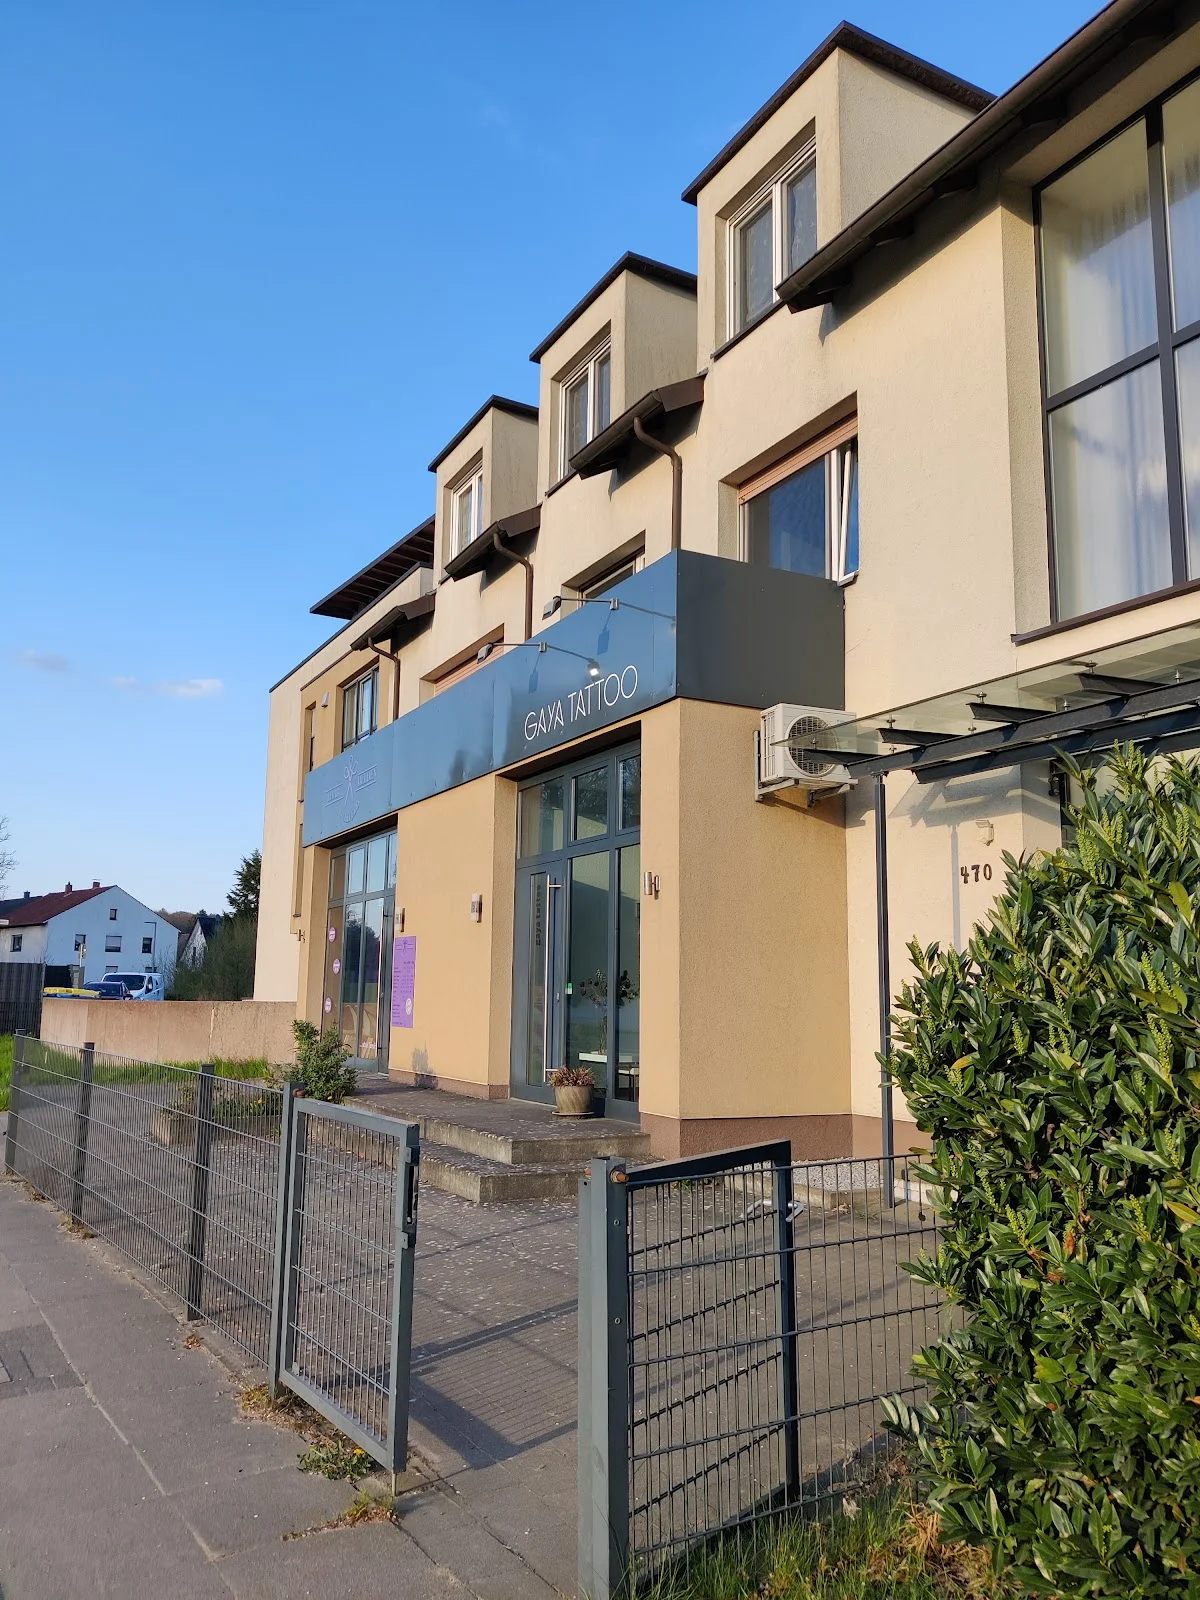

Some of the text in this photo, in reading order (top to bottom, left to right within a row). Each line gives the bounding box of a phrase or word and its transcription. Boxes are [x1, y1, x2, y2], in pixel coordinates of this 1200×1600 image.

[524, 665, 638, 741] GAYA TATTOO
[960, 863, 992, 884] 470
